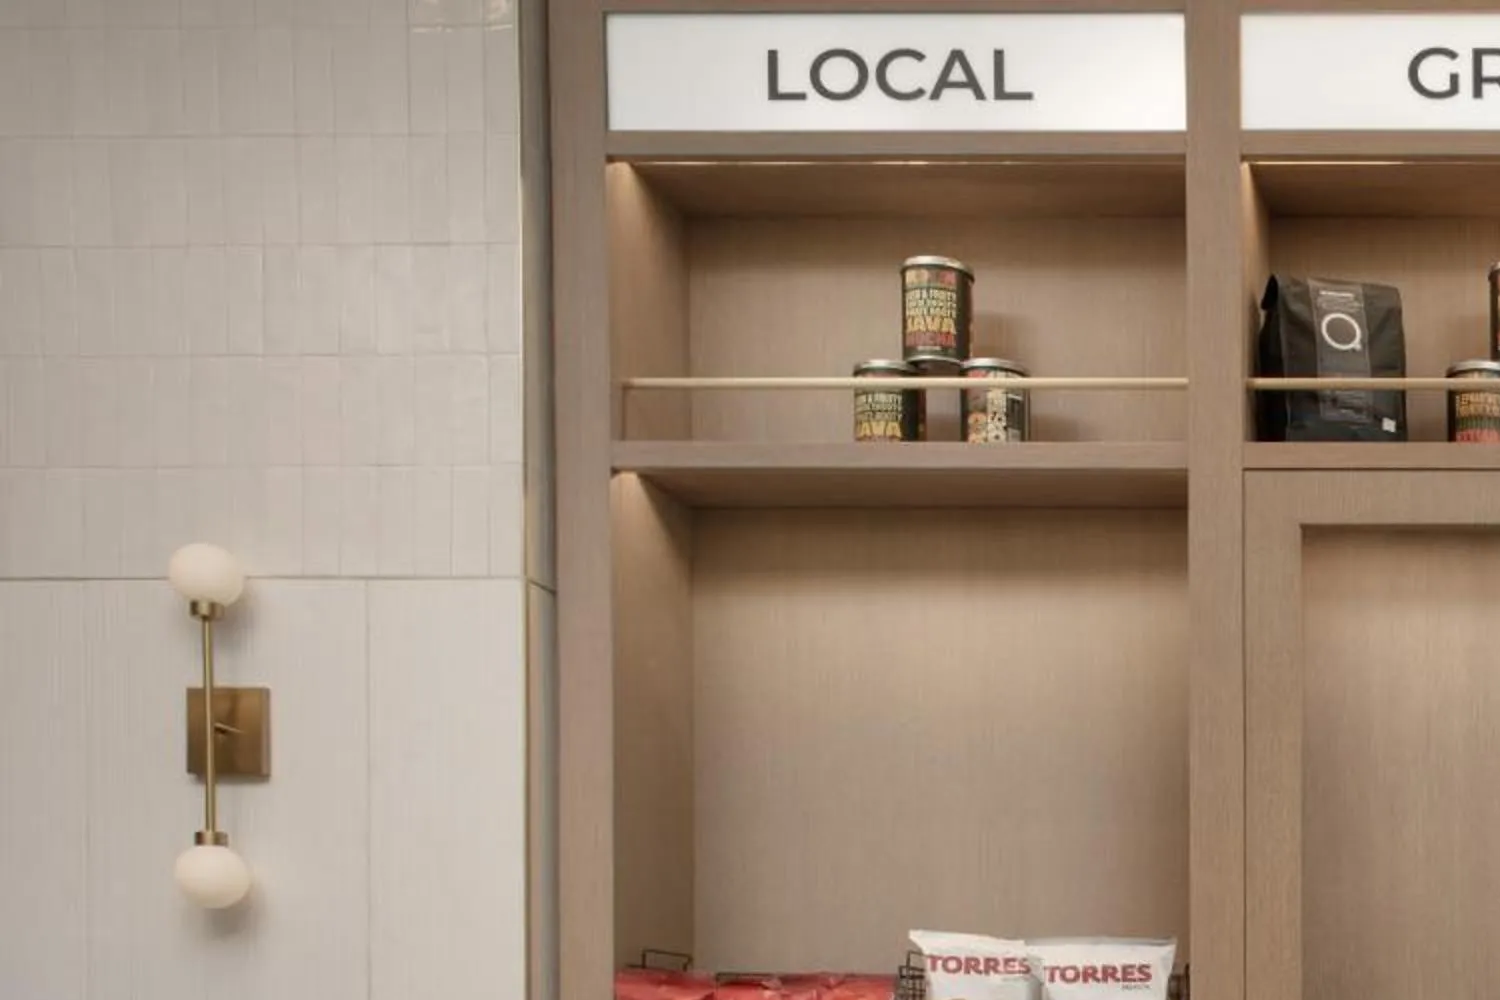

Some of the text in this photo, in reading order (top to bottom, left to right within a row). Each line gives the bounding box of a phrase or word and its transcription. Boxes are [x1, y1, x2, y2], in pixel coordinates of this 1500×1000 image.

[767, 49, 1033, 99] LOCAL
[927, 954, 1032, 976] TORRES
[1045, 963, 1153, 984] TORRES
